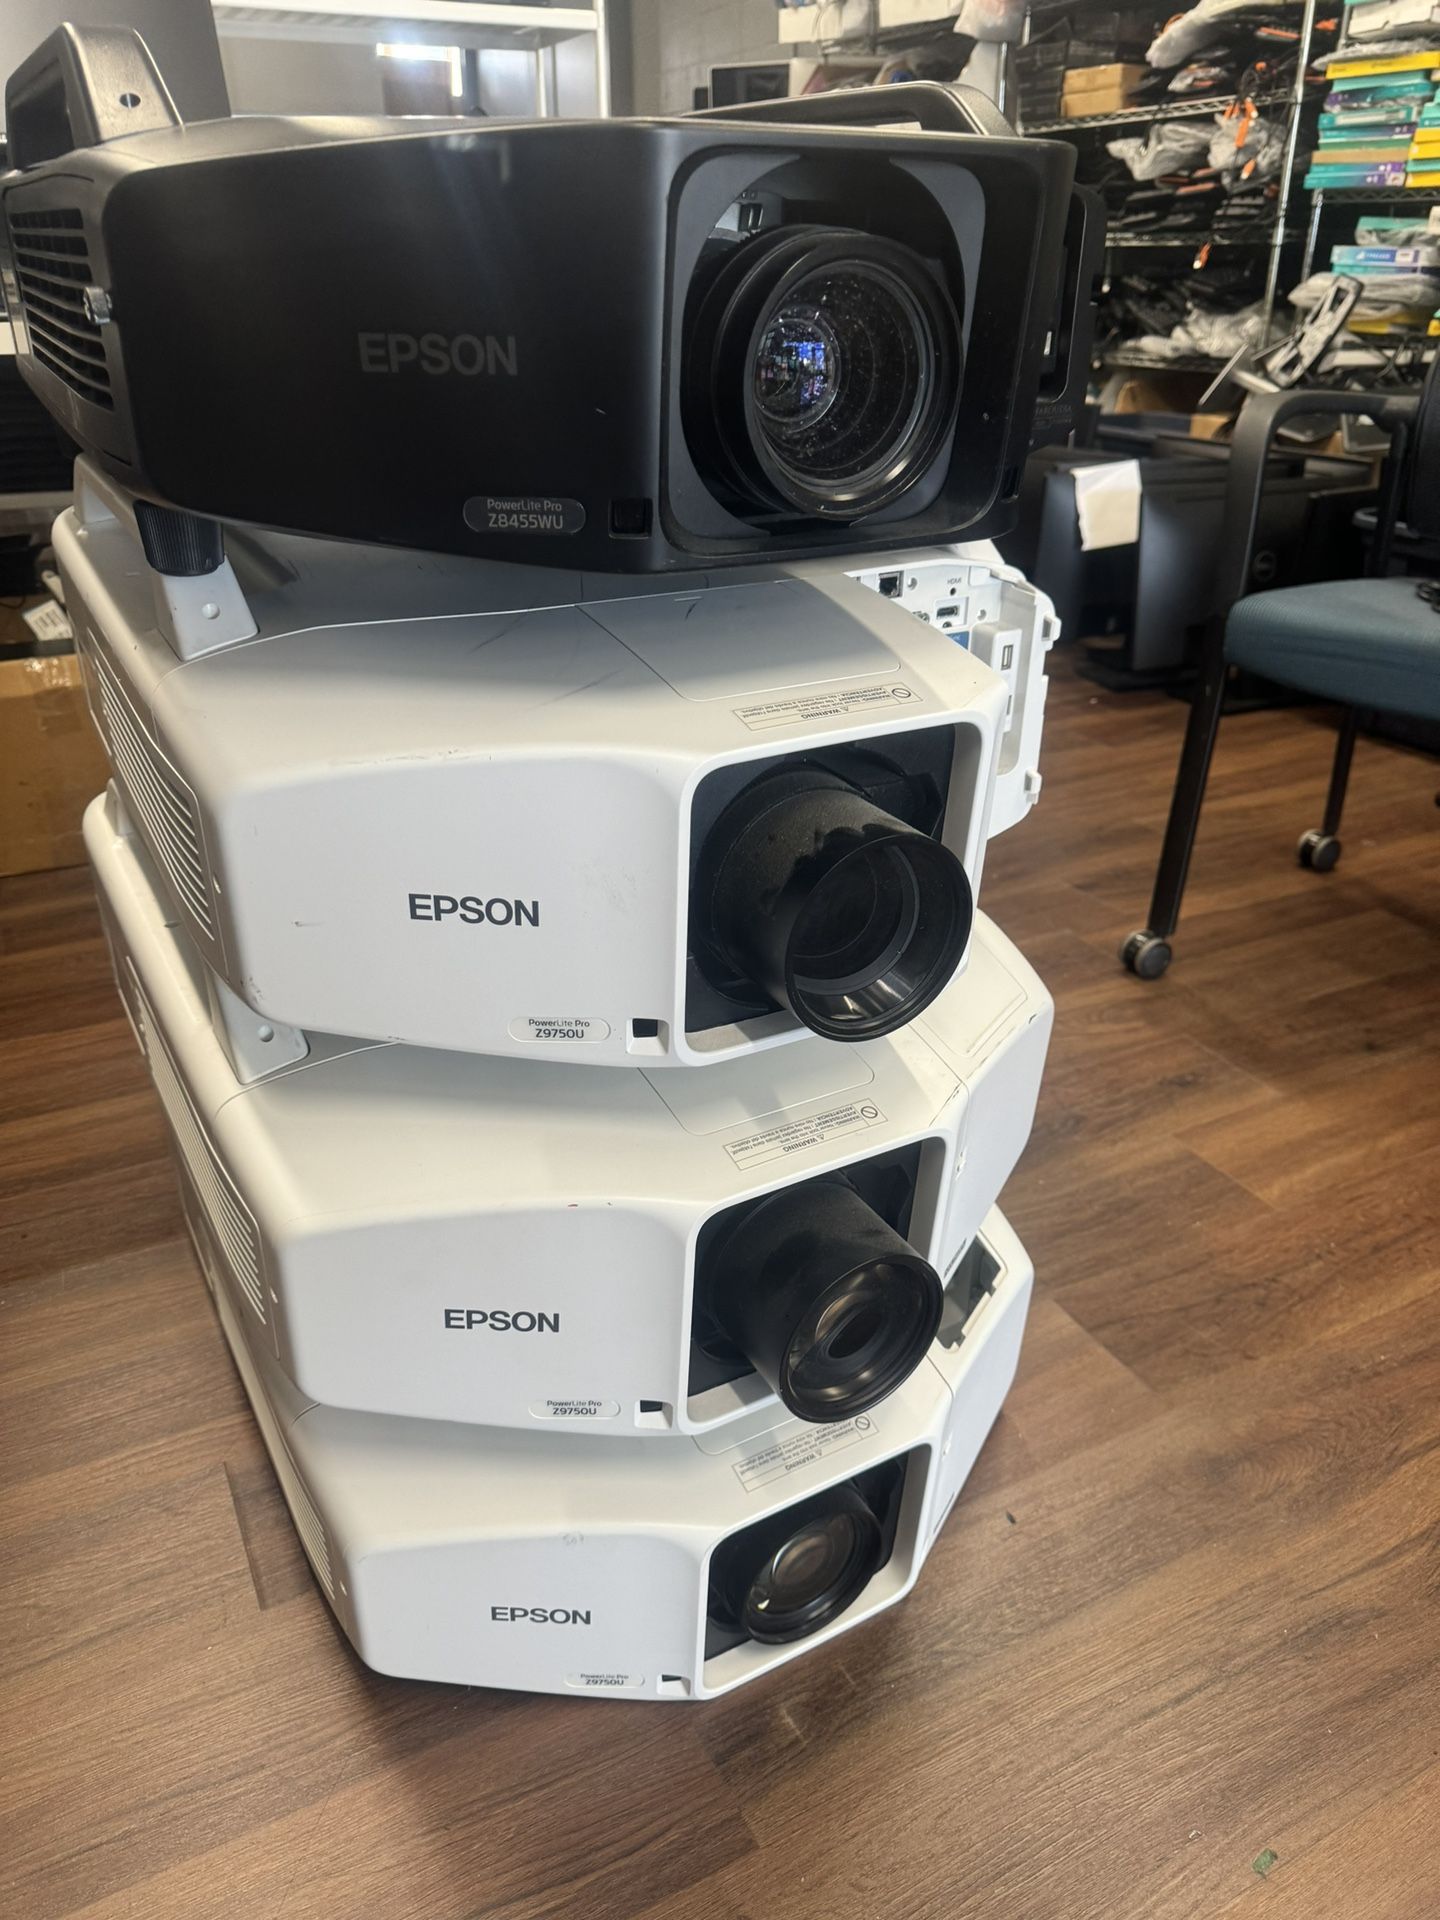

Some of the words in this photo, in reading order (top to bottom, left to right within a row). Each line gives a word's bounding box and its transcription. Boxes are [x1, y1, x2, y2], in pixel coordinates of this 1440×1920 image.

[358, 332, 518, 376] EPSON
[487, 498, 541, 511] PowerLite
[544, 500, 562, 511] Pro
[488, 513, 563, 529] Z8455WU
[799, 709, 841, 718] WARNING
[408, 893, 540, 927] EPSON
[528, 1018, 573, 1027] PowerLite
[575, 1019, 590, 1028] Pro
[535, 1028, 584, 1039] Z9750U
[781, 1136, 817, 1151] WARNING
[444, 1308, 560, 1333] EPSON
[546, 1399, 587, 1407] PowerLite
[588, 1399, 602, 1407] Pro
[552, 1407, 597, 1415] Z9750U
[491, 1606, 591, 1625] EPSON
